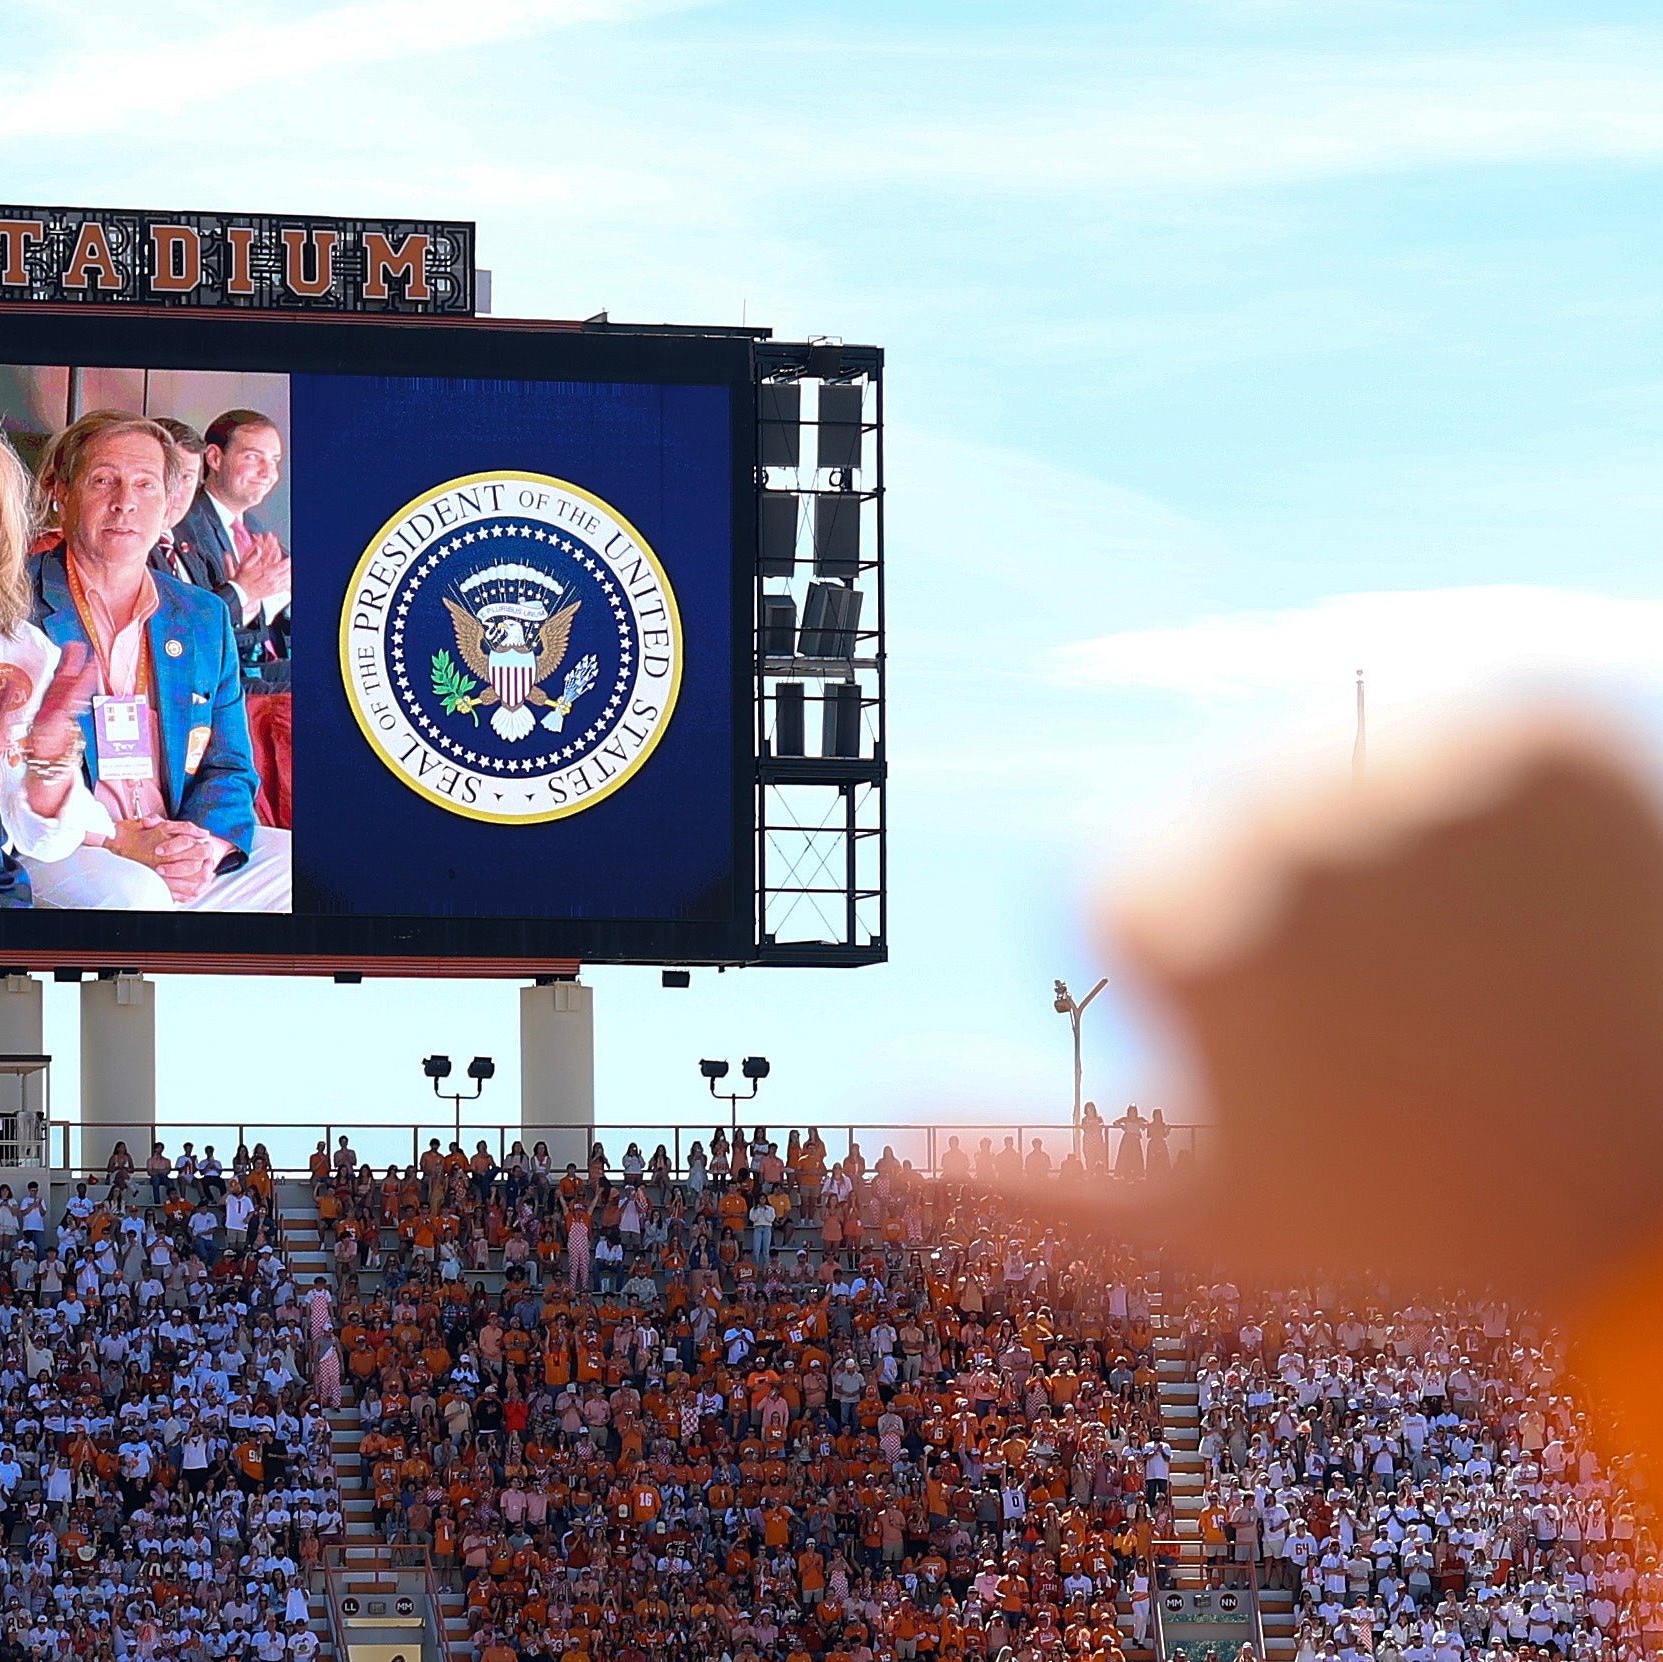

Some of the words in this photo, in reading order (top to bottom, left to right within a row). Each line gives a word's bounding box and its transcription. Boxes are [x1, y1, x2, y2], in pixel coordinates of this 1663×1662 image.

[519, 489, 551, 510] OF
[556, 498, 601, 535] THE
[353, 484, 506, 635] PRESIDENT
[603, 532, 670, 679] UNITED
[357, 645, 380, 696] THE
[370, 701, 397, 731] OF
[547, 699, 658, 805] STATES
[403, 732, 482, 804] SEAL
[639, 1493, 652, 1506] 16
[344, 1602, 357, 1611] LL
[397, 1602, 413, 1611] MM
[1166, 1599, 1183, 1607] MM
[1221, 1598, 1236, 1606] NN
